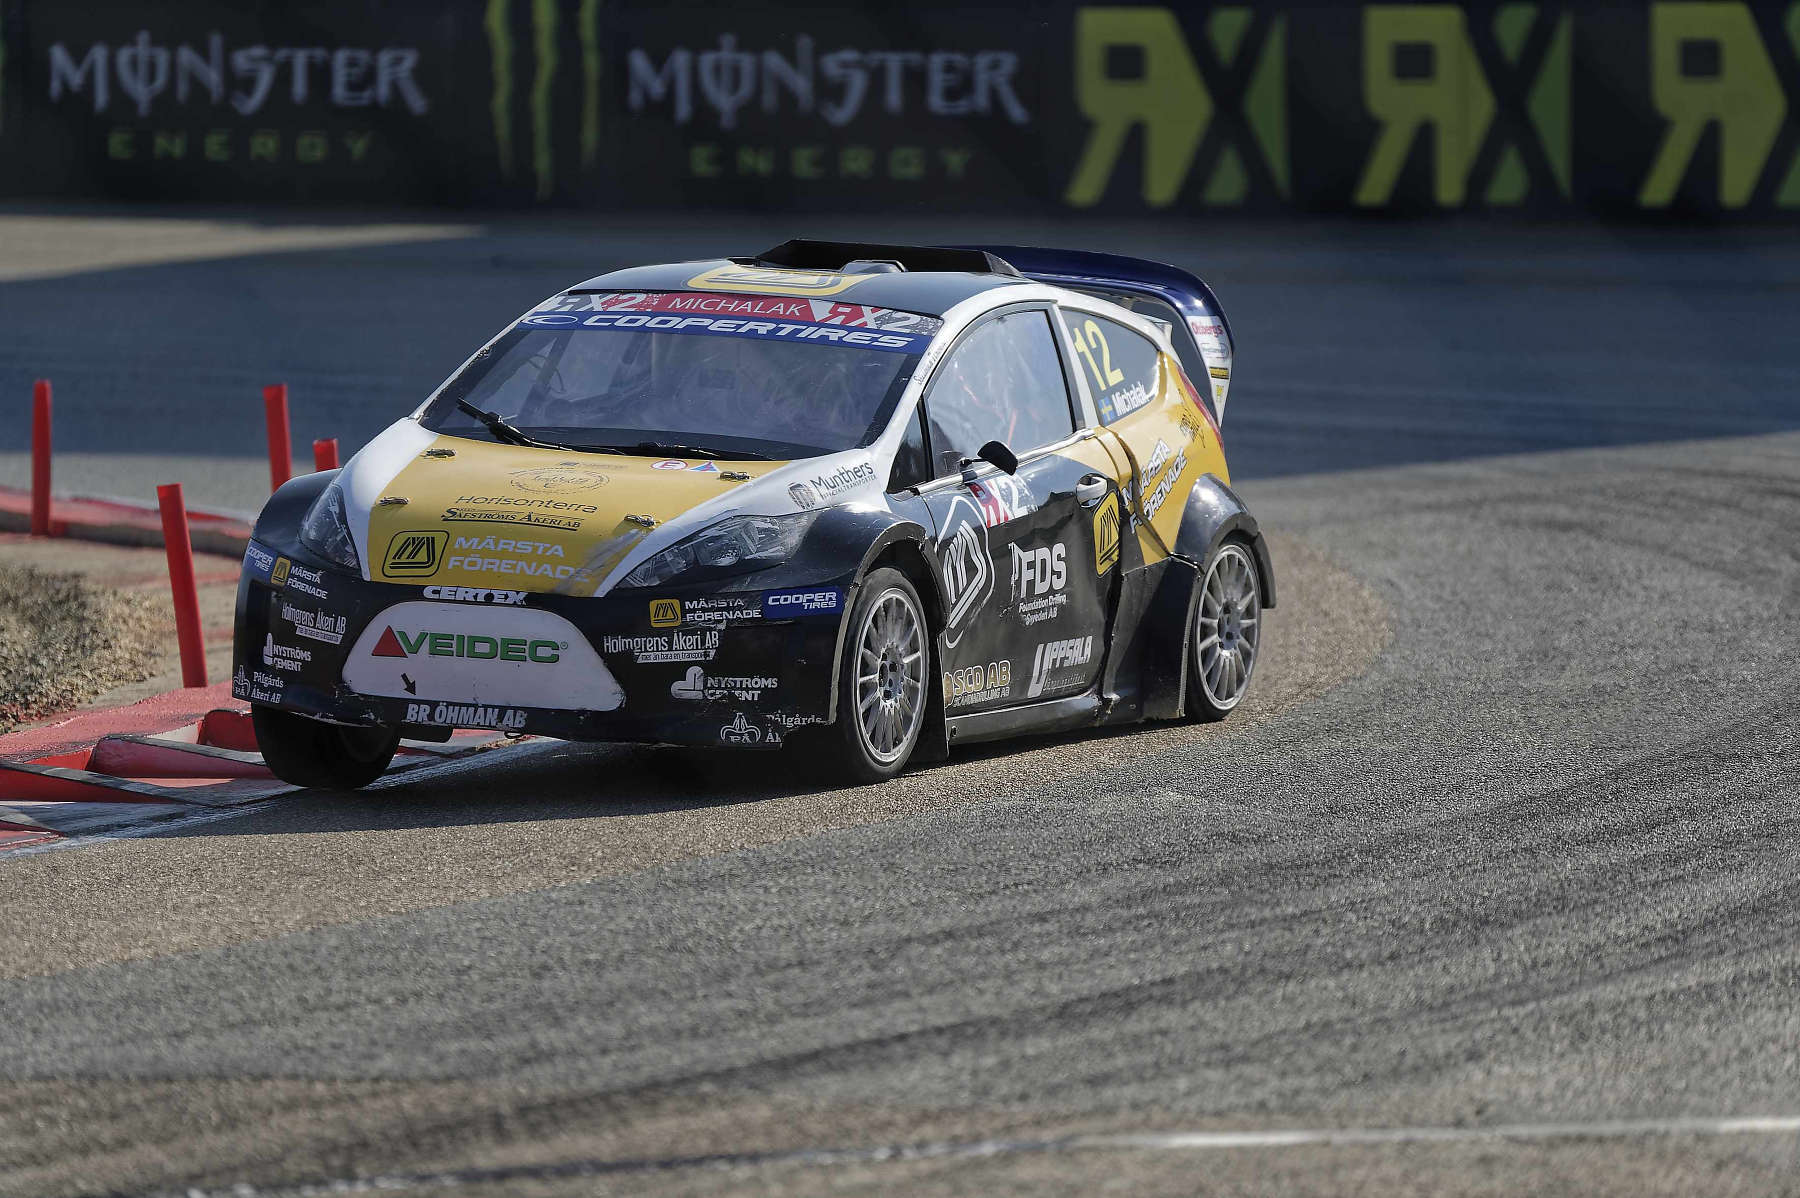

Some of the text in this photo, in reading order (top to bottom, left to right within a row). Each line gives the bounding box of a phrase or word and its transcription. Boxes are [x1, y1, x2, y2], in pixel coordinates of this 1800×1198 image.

[49, 30, 428, 117] MONSTER
[627, 34, 1030, 130] MONSTER
[107, 131, 374, 163] ENERGY
[690, 146, 972, 179] ENERGY
[668, 297, 808, 316] MICHALAK
[1074, 320, 1125, 391] 12
[1111, 381, 1148, 417] Michalak
[810, 462, 874, 500] Munthers
[455, 495, 598, 514] Horisonterra
[454, 535, 565, 558] MÄRSTA
[1020, 542, 1067, 599] FDS
[423, 586, 528, 605] CERTEX
[685, 597, 745, 609] MÄRSTA
[768, 592, 837, 605] COOPER
[803, 601, 837, 610] TIRES
[335, 615, 347, 635] AB
[686, 609, 762, 621] FÖRENADE
[273, 643, 312, 662] NYSTRÖMS
[603, 630, 719, 654] Holmgrens Åkeri AB
[273, 655, 303, 672] CEMENT
[986, 660, 1011, 689] AB
[1028, 636, 1093, 698] UPPSALA
[707, 675, 778, 688] NYSTRÖMS
[406, 702, 527, 728] BR ÖHMAN AB
